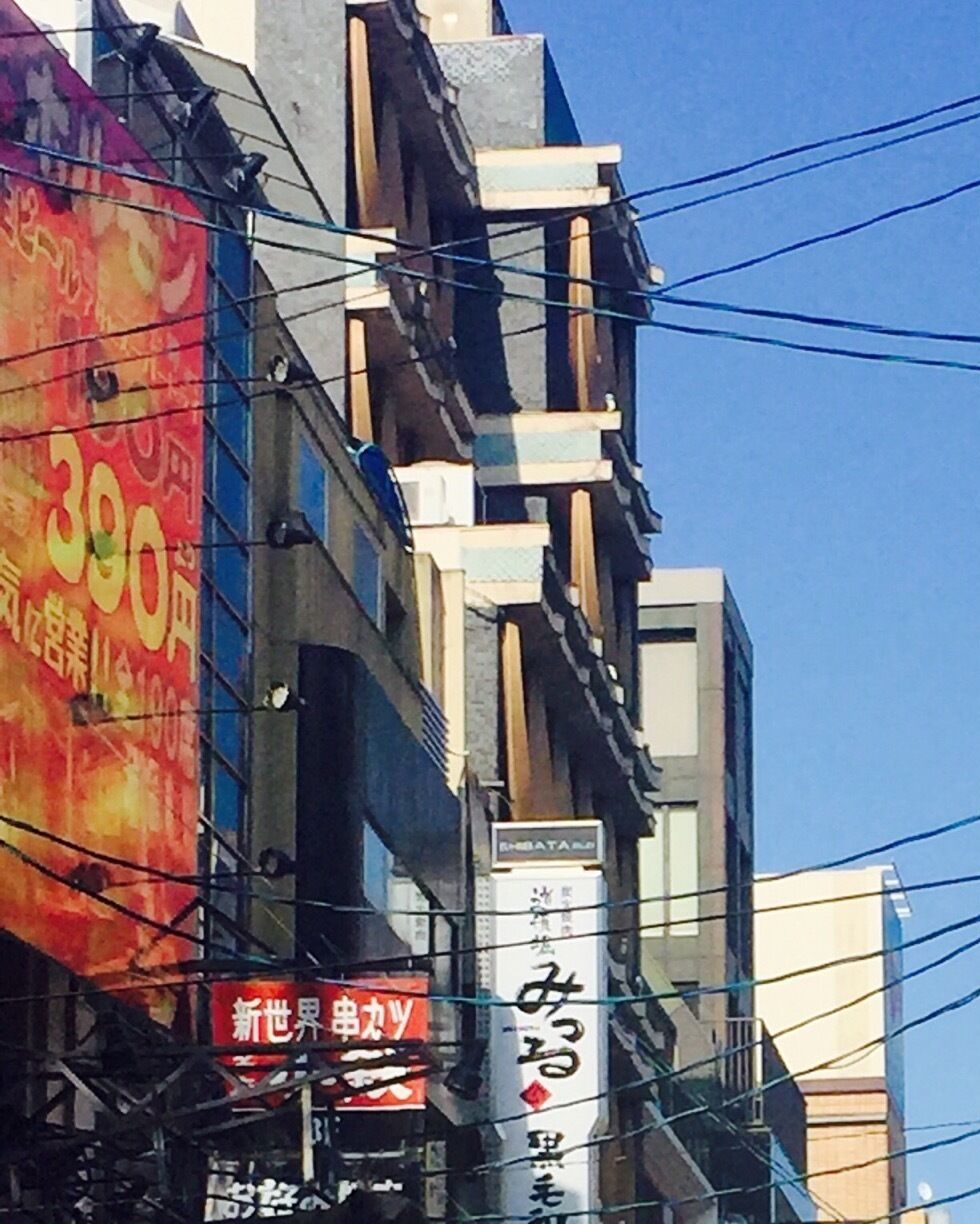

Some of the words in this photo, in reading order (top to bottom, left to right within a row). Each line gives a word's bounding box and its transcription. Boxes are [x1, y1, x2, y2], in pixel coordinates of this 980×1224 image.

[231, 996, 324, 1044] 新世界
[331, 995, 415, 1044] 串カツ
